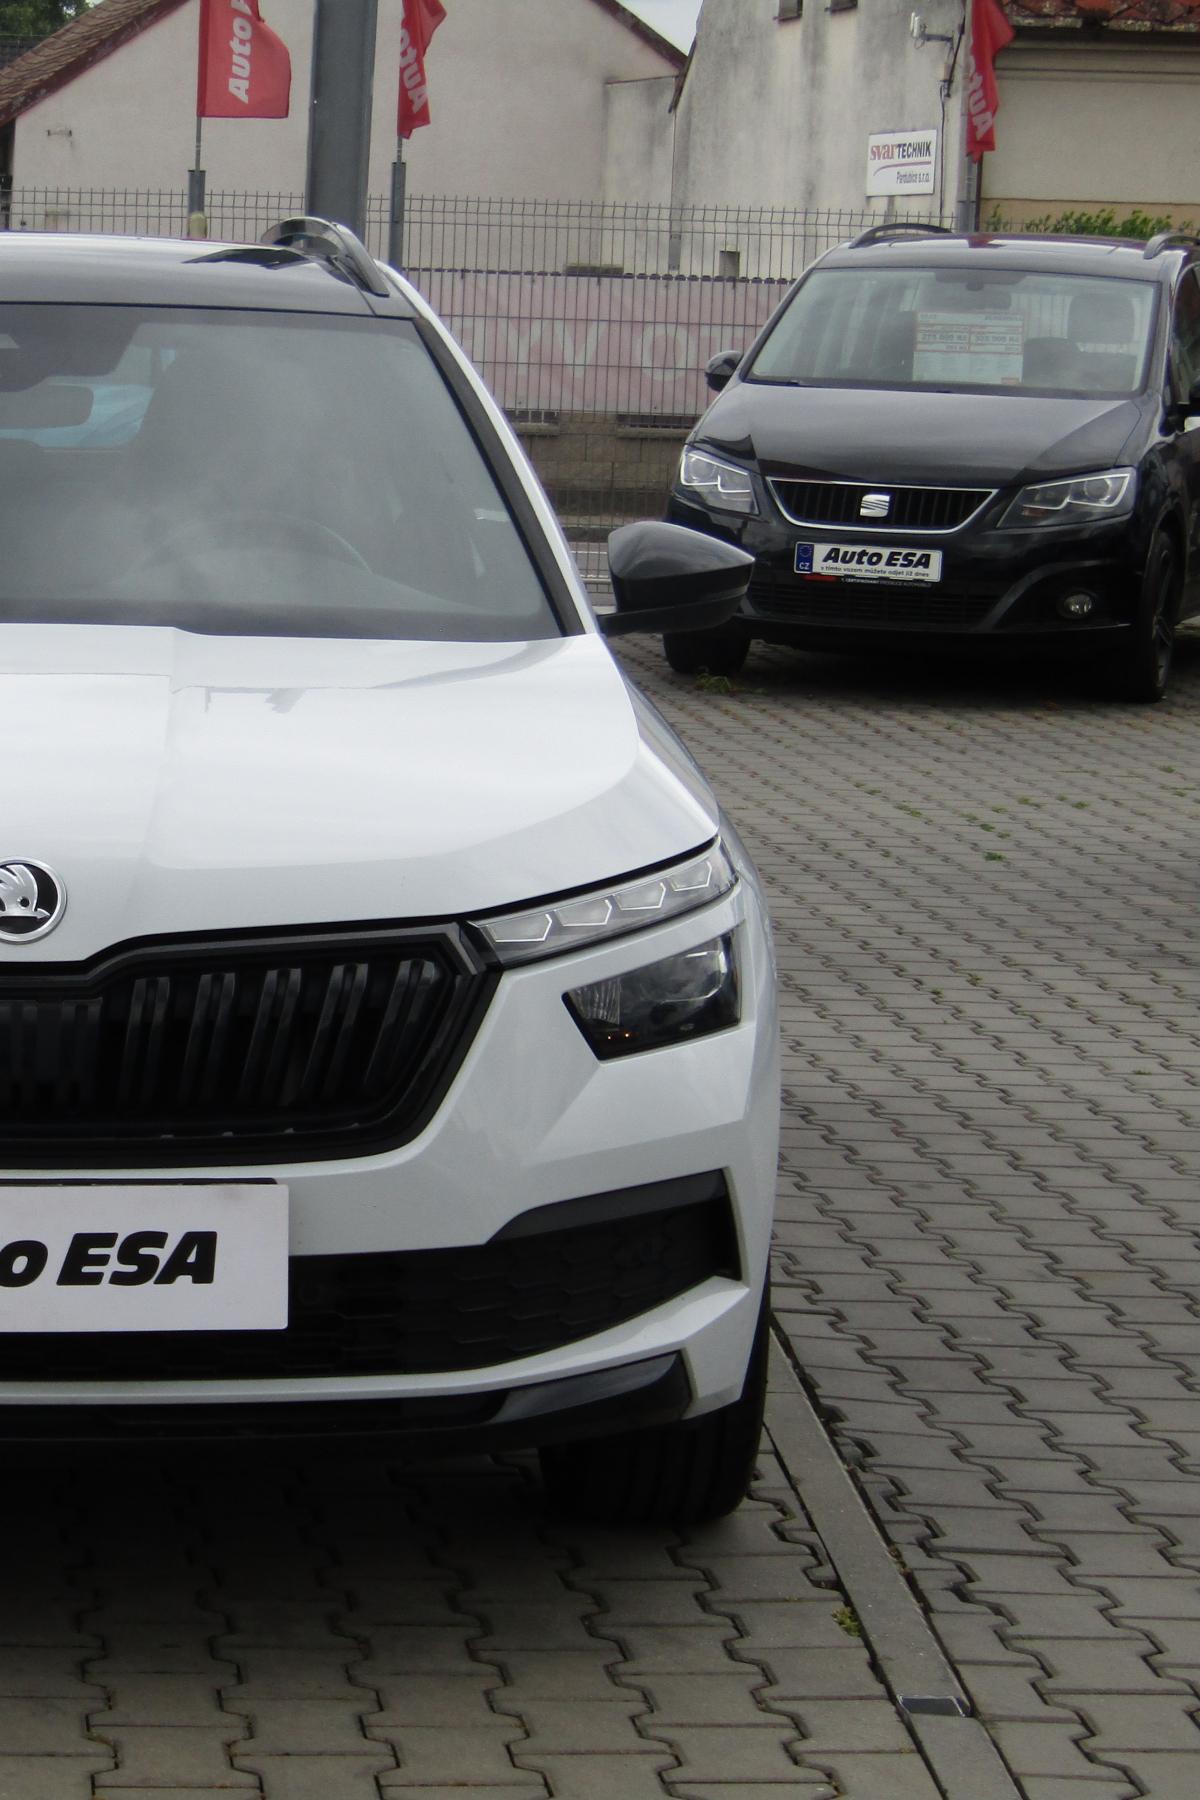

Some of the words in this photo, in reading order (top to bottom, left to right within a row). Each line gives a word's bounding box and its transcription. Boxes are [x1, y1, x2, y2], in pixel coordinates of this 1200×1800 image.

[228, 16, 252, 105] Auto
[799, 562, 810, 570] CZ
[822, 548, 883, 567] Auto
[885, 551, 931, 569] ESA
[56, 1231, 218, 1286] ESA
